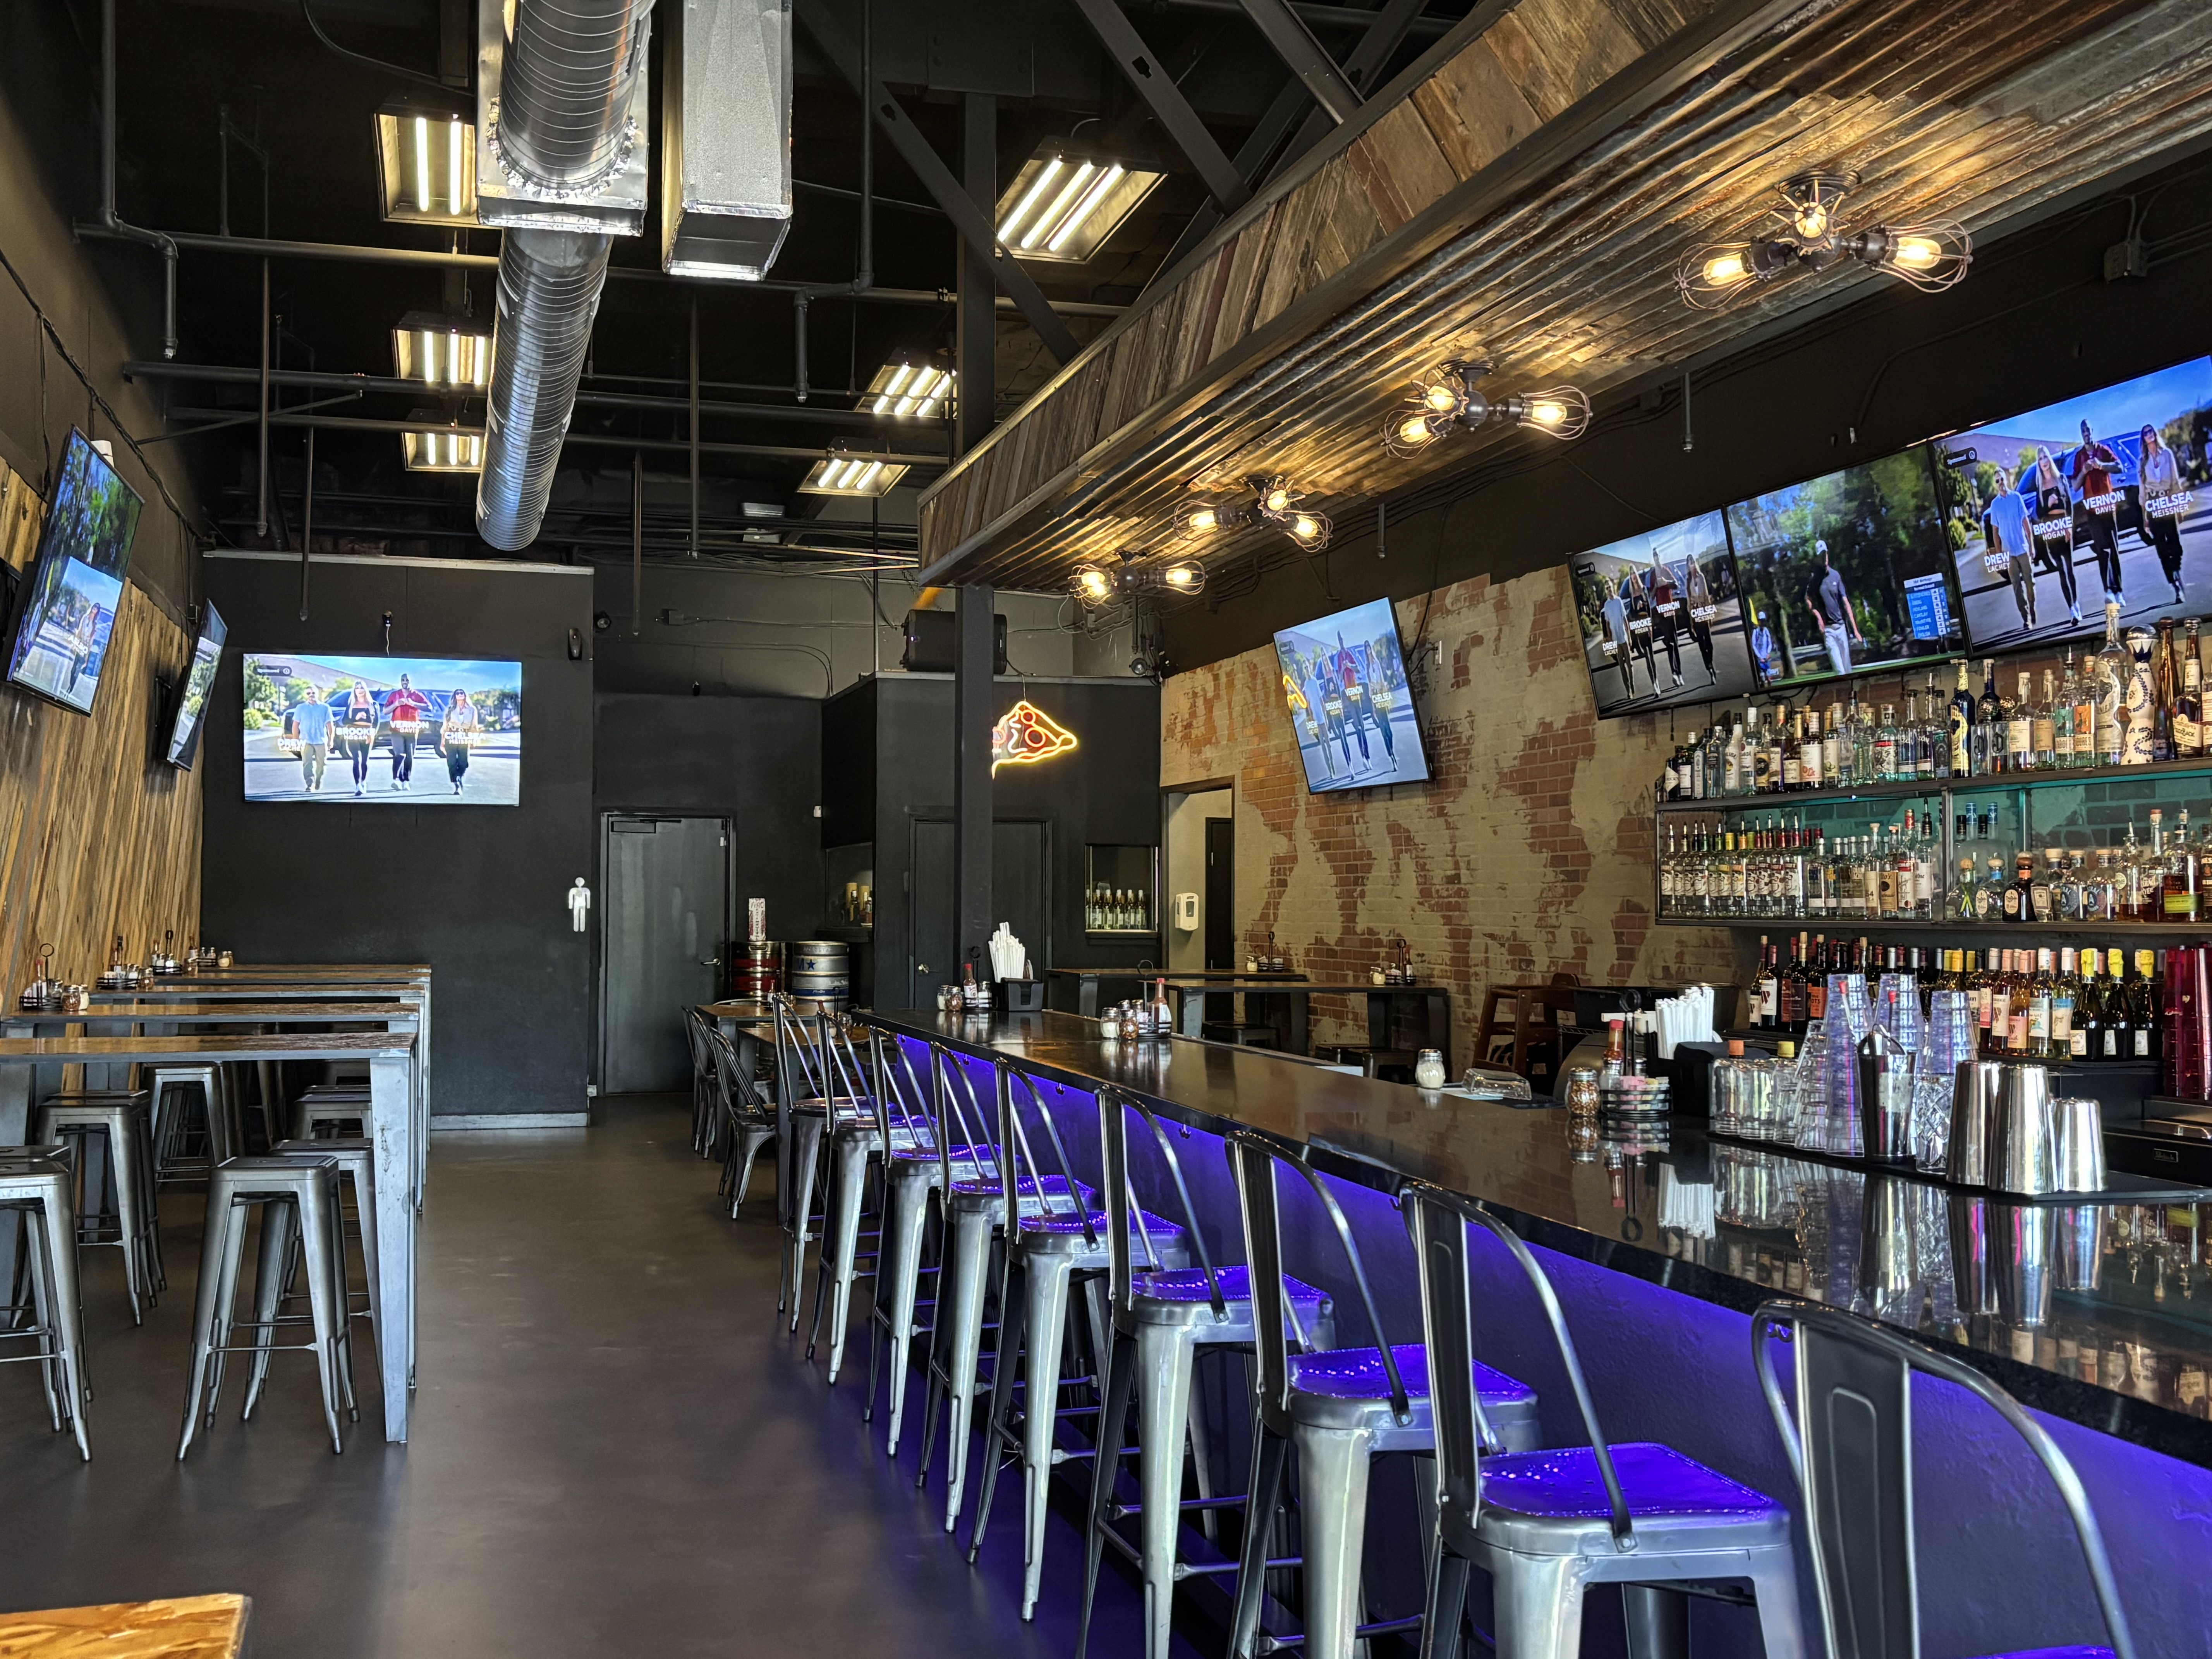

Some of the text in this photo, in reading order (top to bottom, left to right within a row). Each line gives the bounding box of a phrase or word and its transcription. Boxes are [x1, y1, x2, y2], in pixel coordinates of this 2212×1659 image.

[2083, 490, 2125, 510] VERNON
[2145, 491, 2193, 512] CHELSEA
[2095, 504, 2116, 515] DAVIS
[2152, 504, 2189, 519] MEISSNER
[2033, 516, 2072, 535] BROOKE
[2042, 530, 2066, 541] HOGAN
[1984, 551, 2010, 566] DREW
[1987, 562, 2010, 573] LACHEY
[1691, 605, 1717, 618] CHELSEA
[1629, 617, 1652, 630] BROOKE
